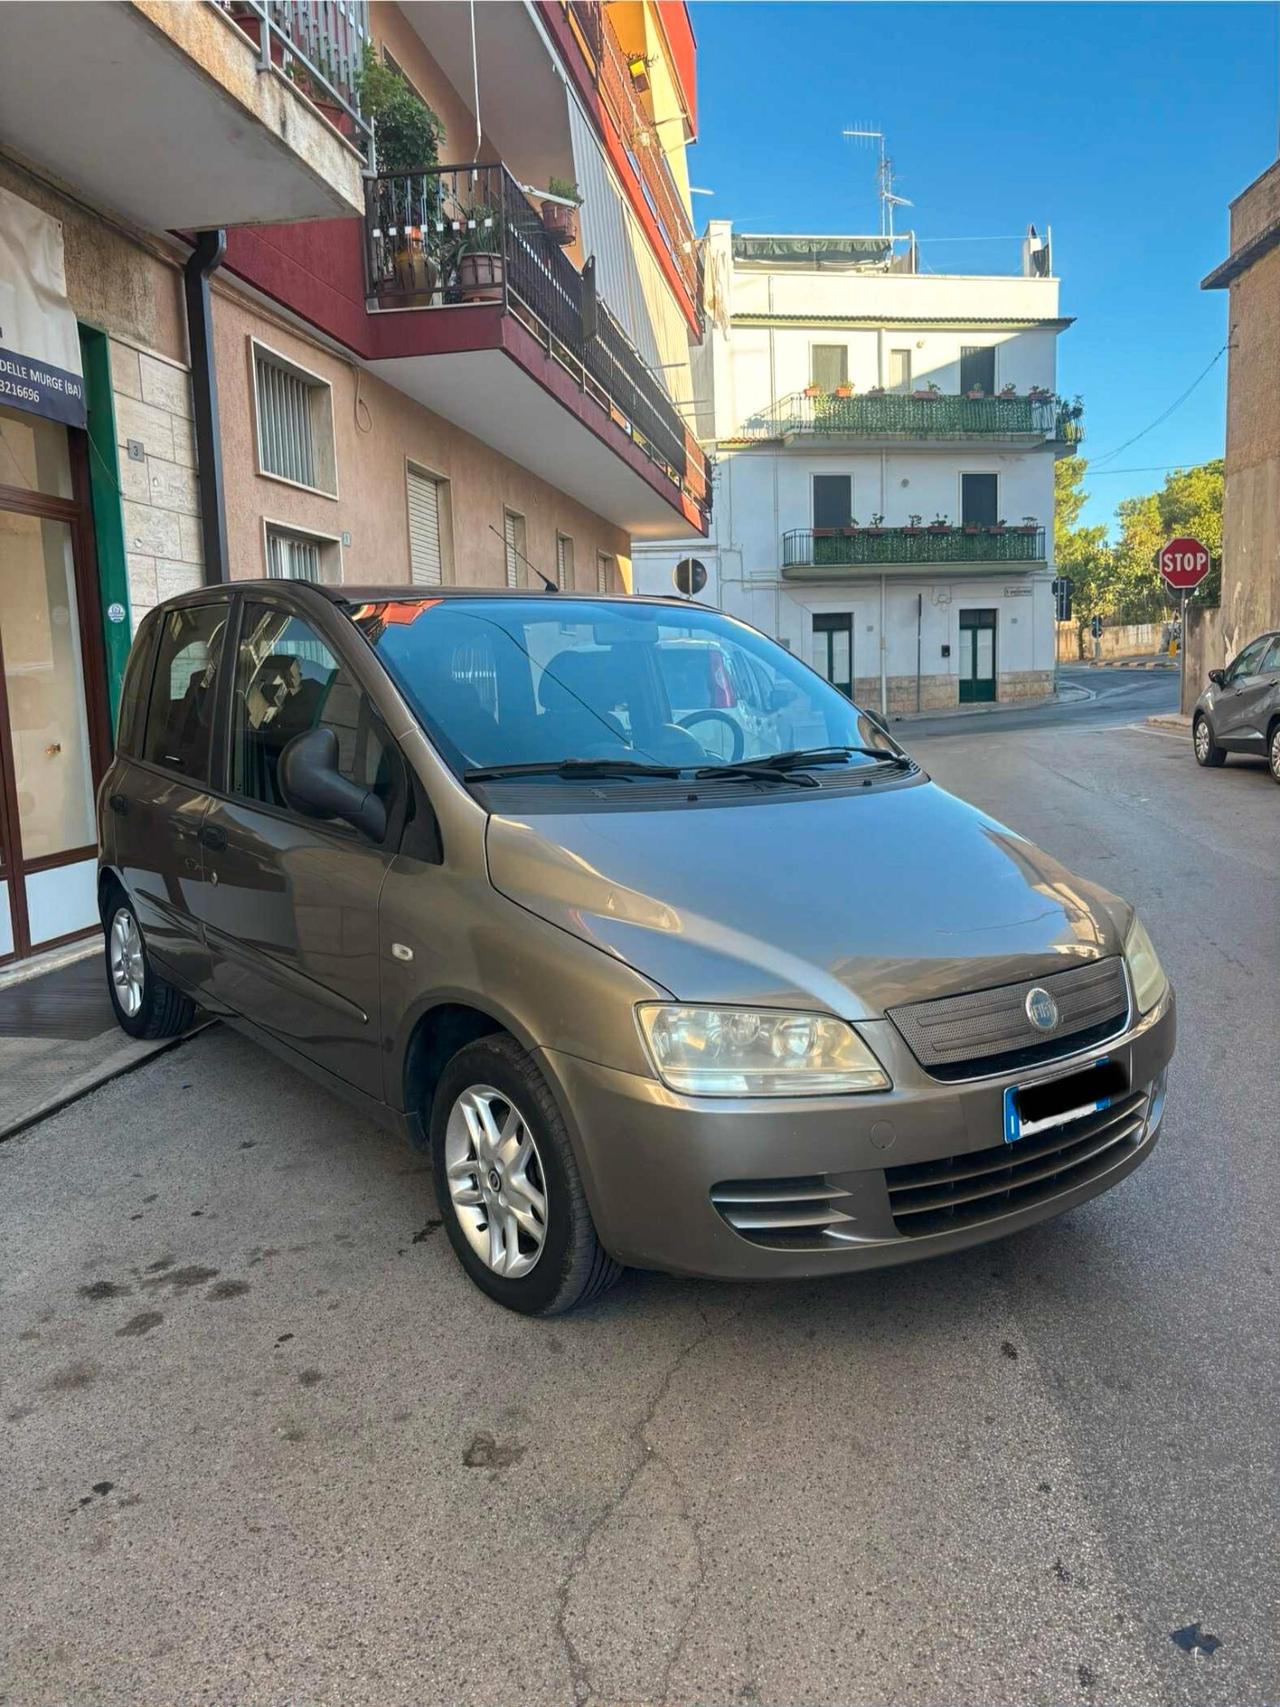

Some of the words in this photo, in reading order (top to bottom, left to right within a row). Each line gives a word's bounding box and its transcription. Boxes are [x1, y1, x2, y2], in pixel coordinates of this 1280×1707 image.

[0, 359, 28, 379] DELLE
[30, 369, 63, 391] MURGE
[64, 380, 82, 399] (BA)
[1163, 552, 1207, 572] STOP
